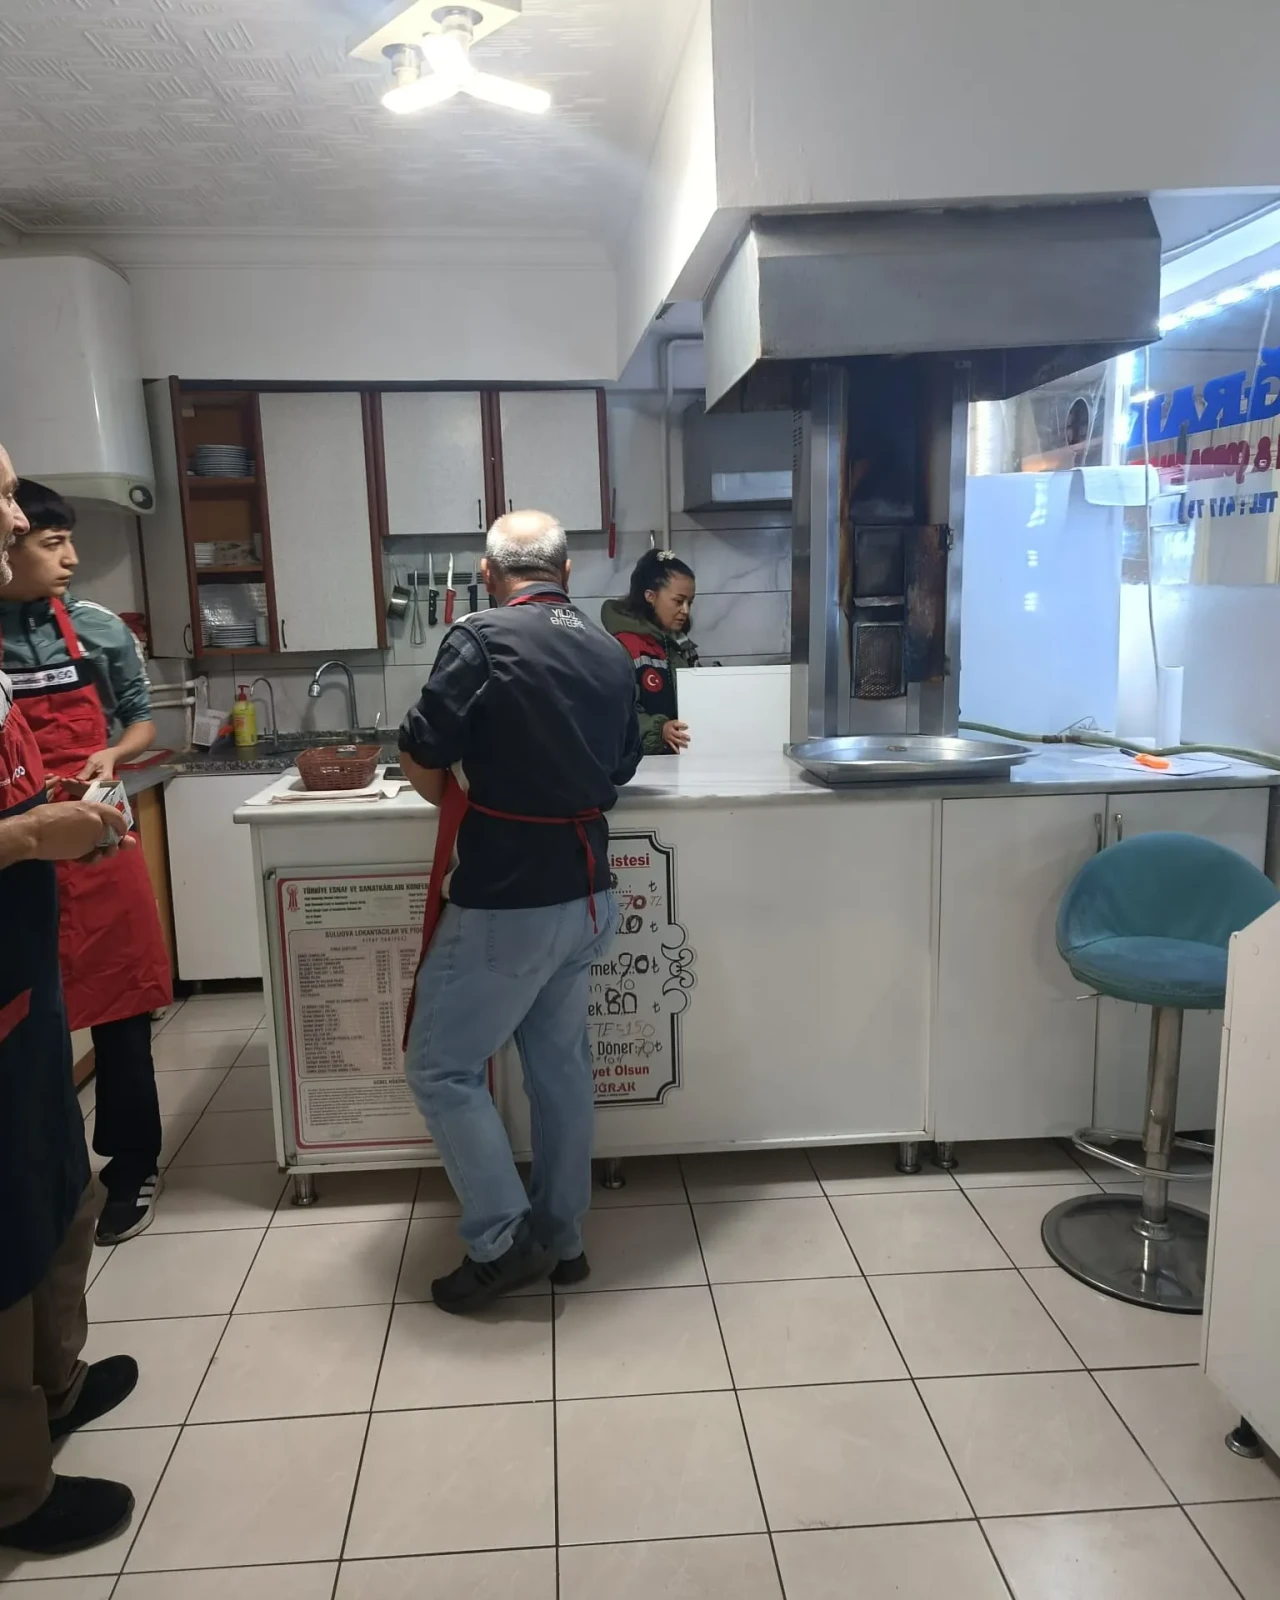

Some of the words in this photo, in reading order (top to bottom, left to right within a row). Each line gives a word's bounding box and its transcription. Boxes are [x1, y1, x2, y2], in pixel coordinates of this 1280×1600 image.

[608, 853, 650, 867] istesi
[588, 959, 617, 976] mek
[615, 1064, 650, 1076] Olsun
